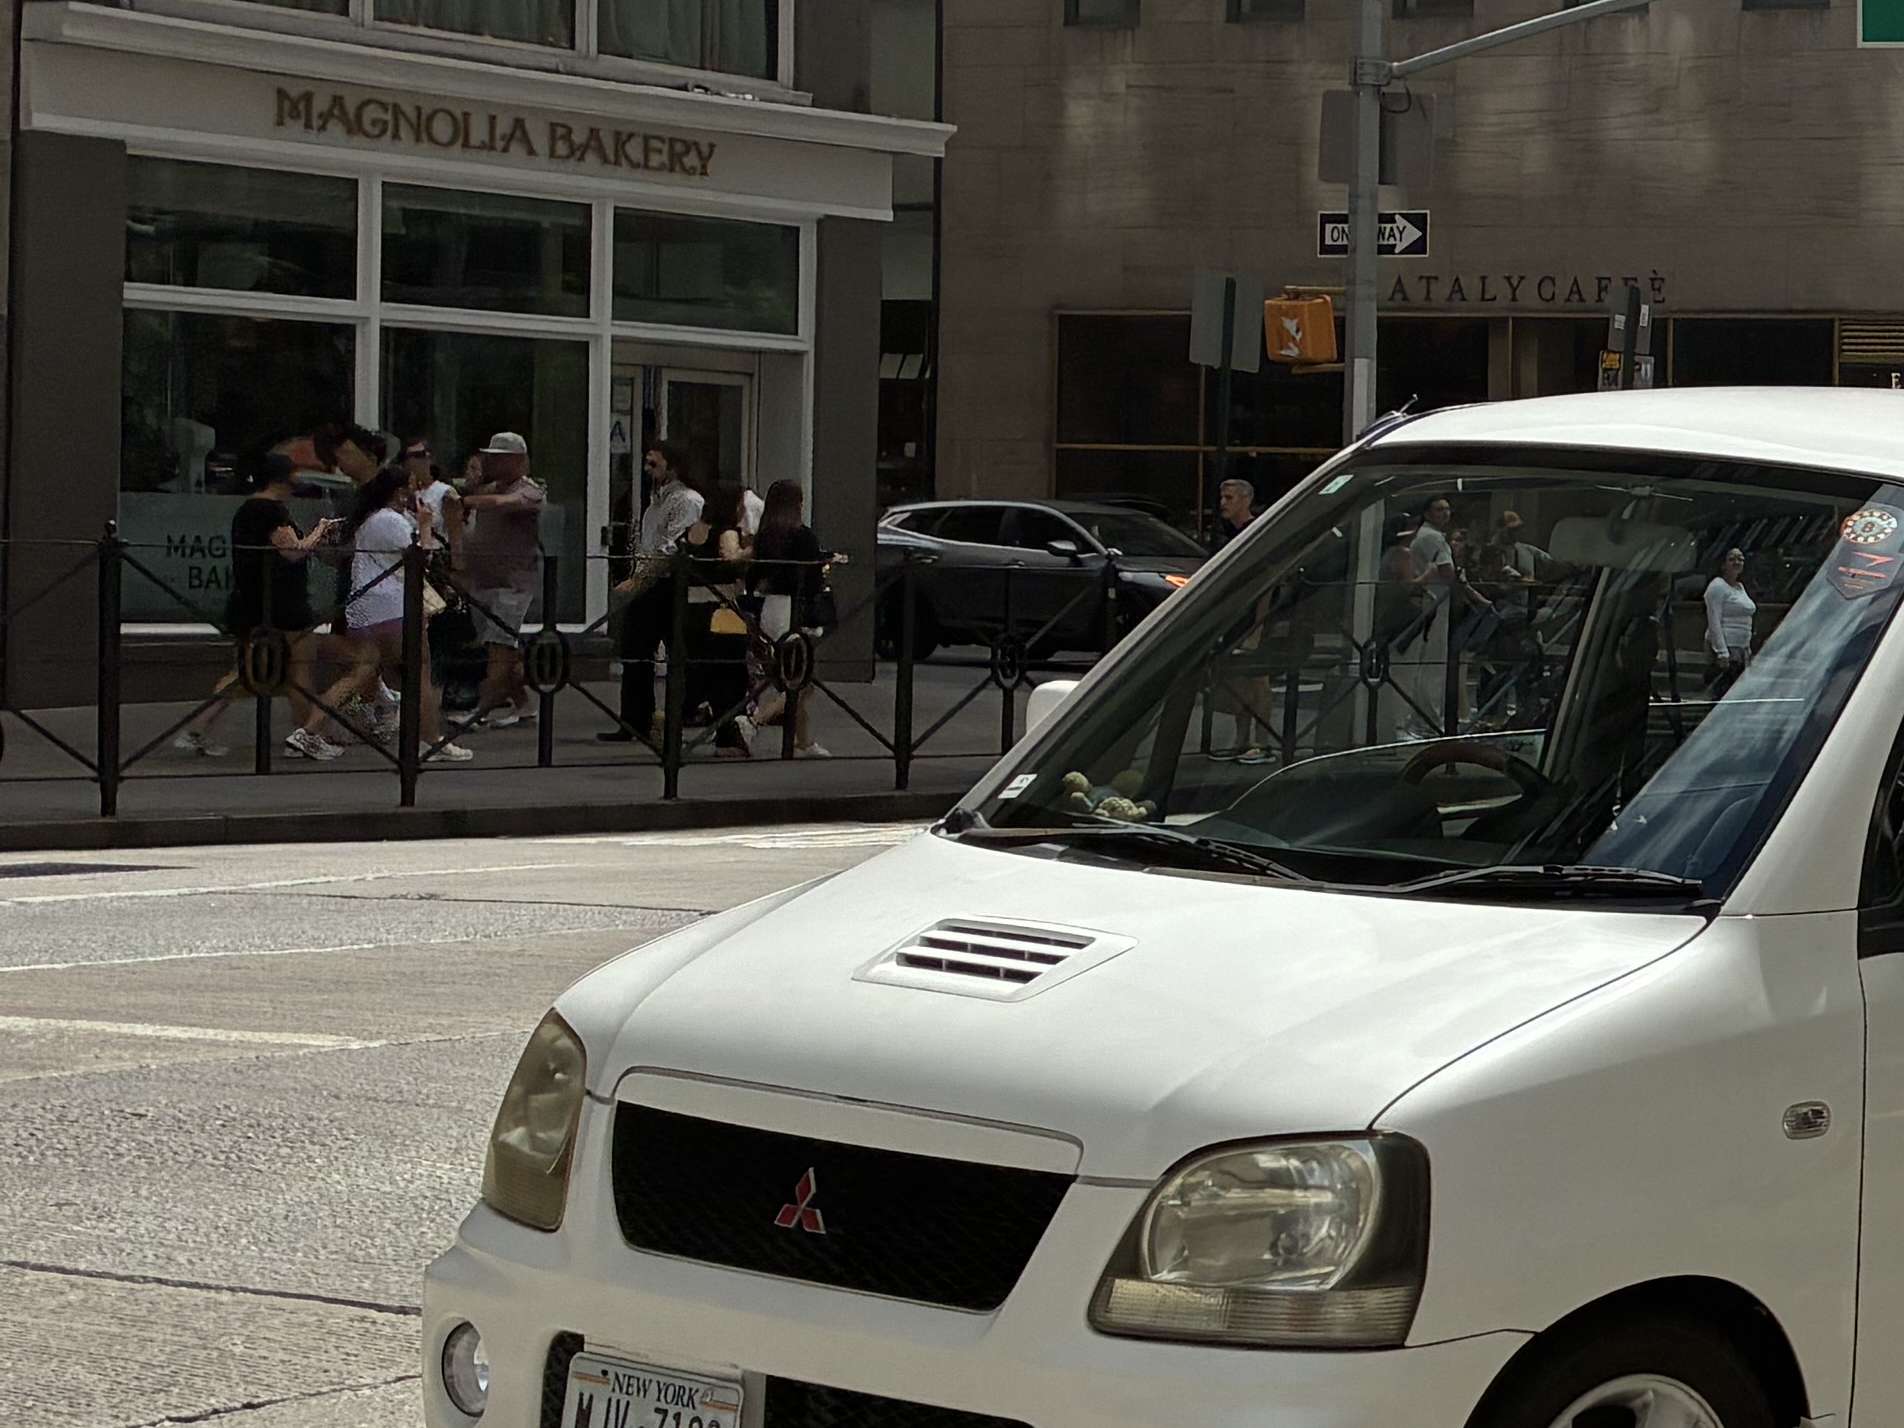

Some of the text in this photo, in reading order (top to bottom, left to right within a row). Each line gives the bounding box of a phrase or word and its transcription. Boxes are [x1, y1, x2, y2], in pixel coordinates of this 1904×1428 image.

[274, 87, 718, 177] MAGNOLIA BAKERY
[611, 1371, 701, 1411] NEW YORK
